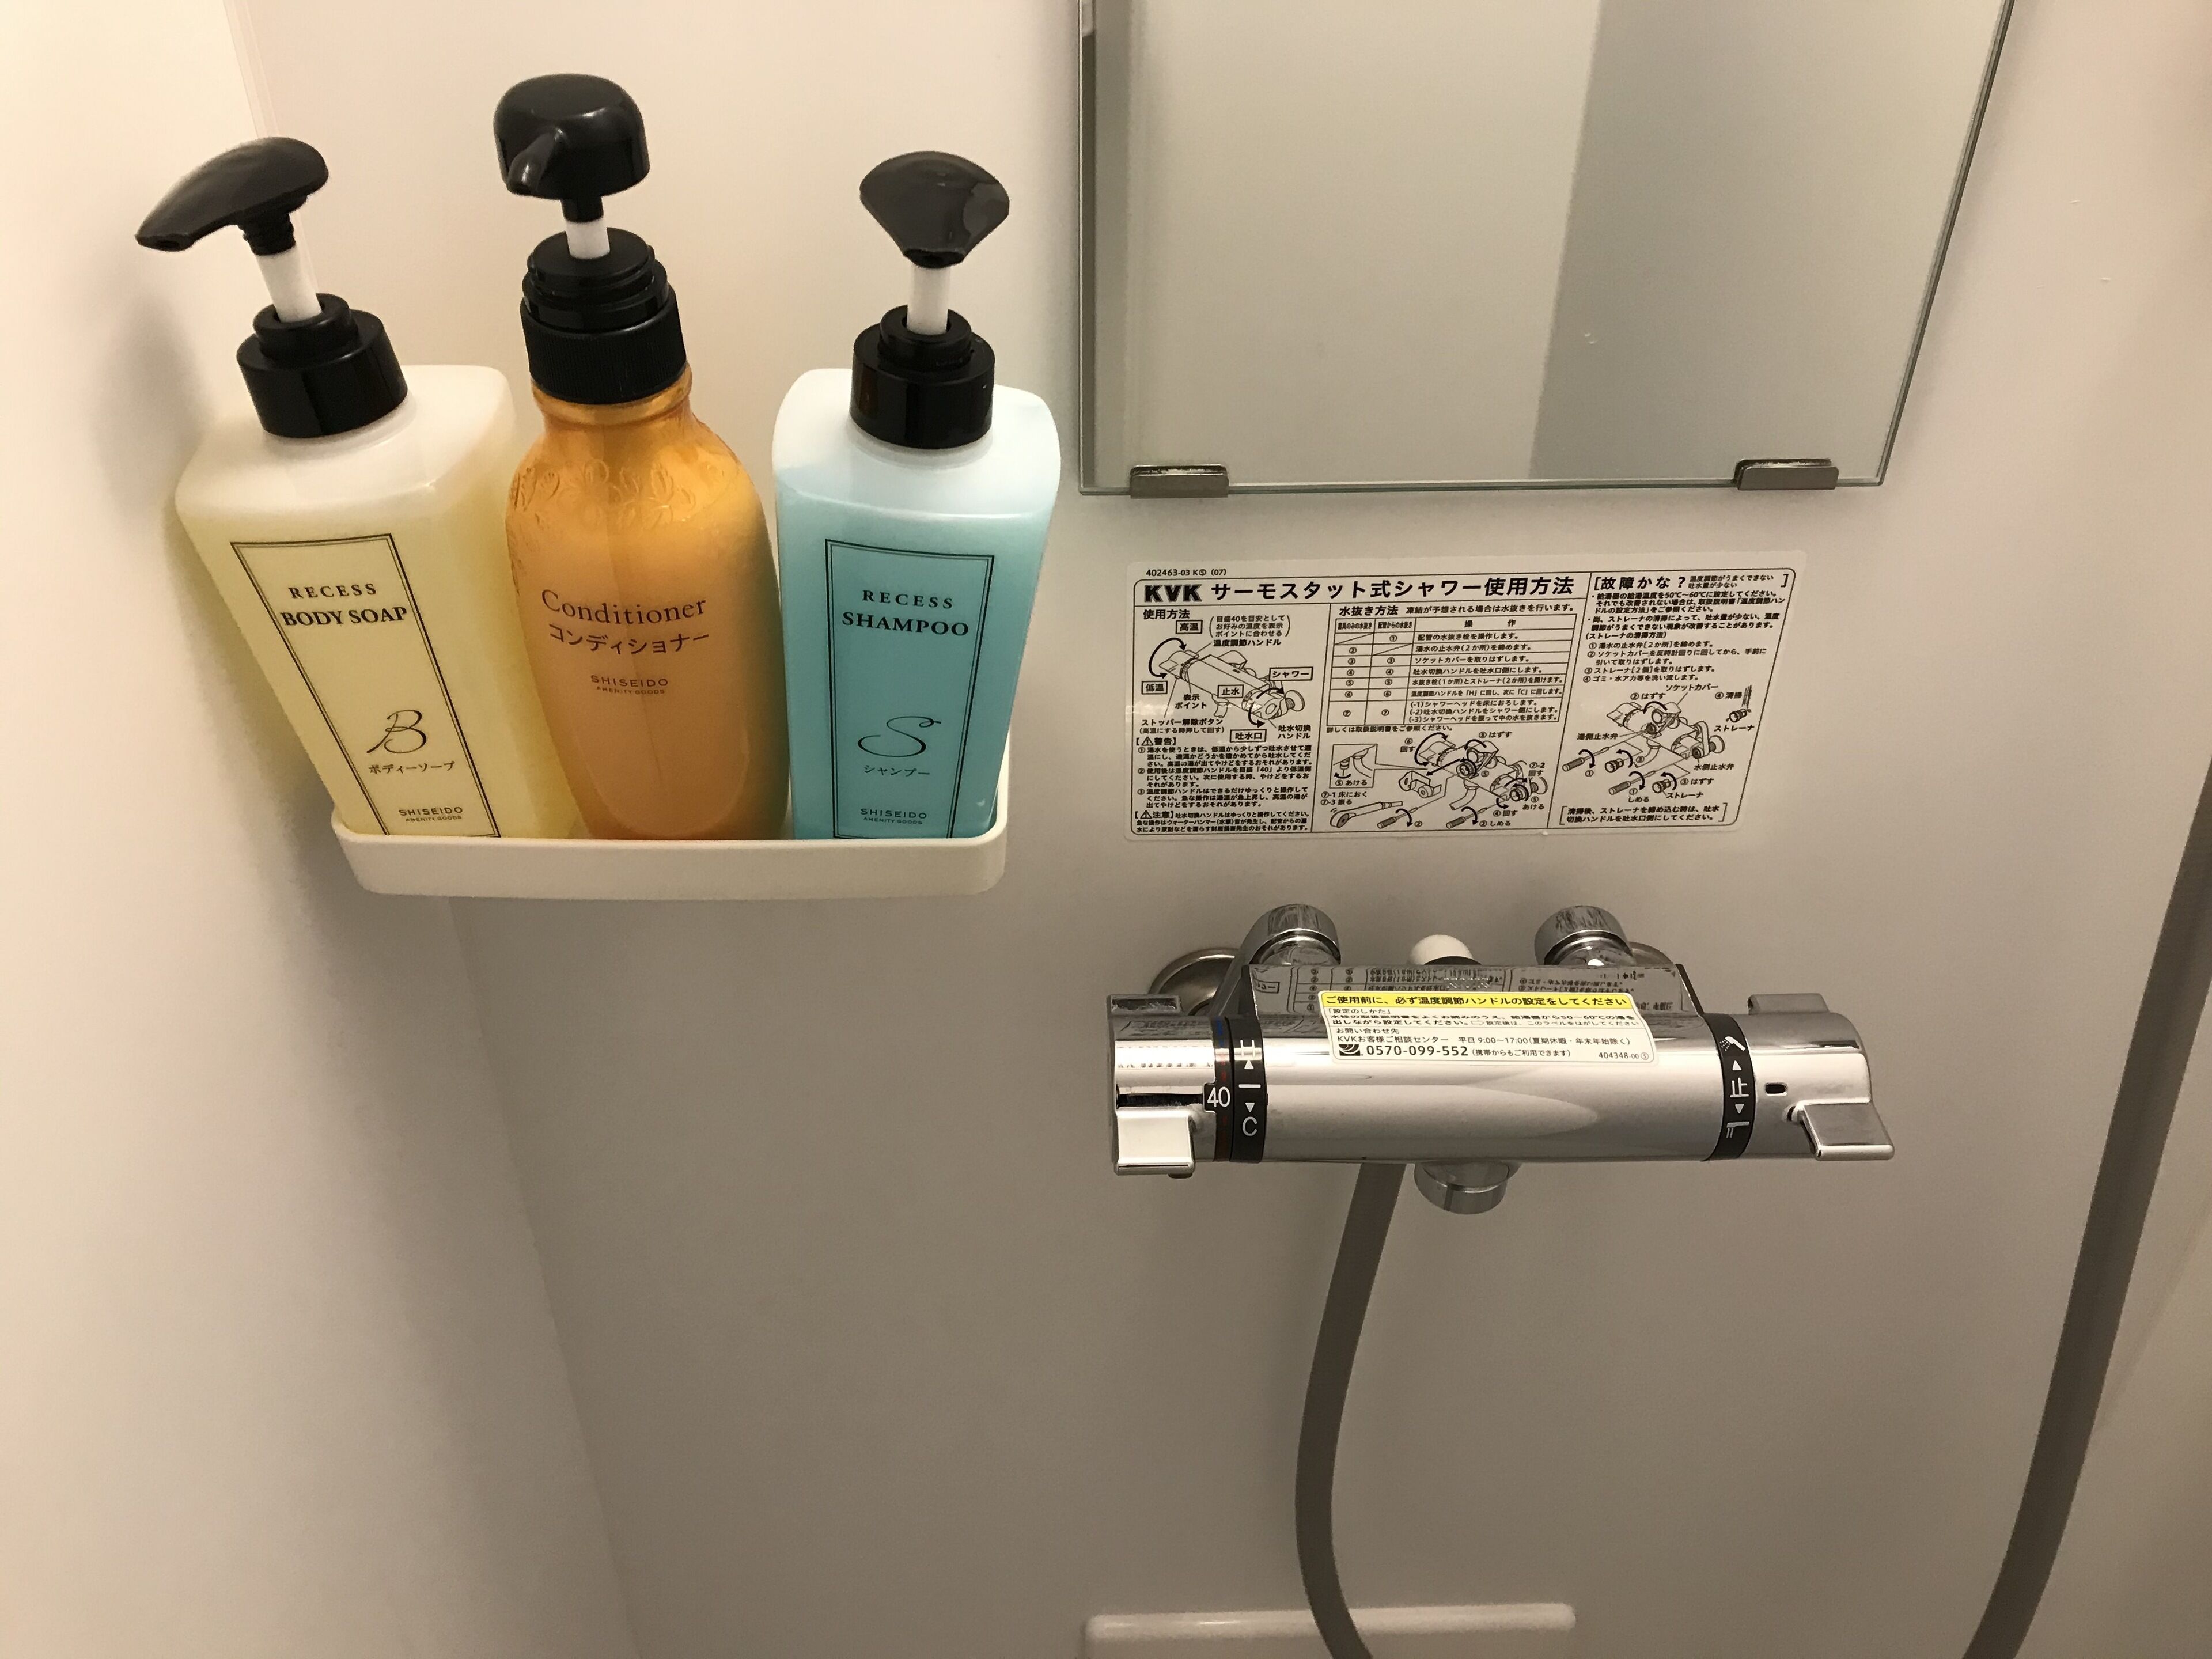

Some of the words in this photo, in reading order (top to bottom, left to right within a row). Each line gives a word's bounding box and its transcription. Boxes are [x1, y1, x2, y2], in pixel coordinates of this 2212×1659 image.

[288, 583, 377, 599] RECESS
[1144, 584, 1202, 603] KVK
[1211, 577, 1574, 600] サーモスタット式シャワー使用方法
[862, 589, 955, 610] RECESS
[541, 589, 707, 626] Conditioner
[1339, 606, 1398, 616] 水抜き方法
[281, 610, 343, 626] BODY
[348, 607, 407, 624] SOAP
[1143, 609, 1190, 620] 使用方法
[842, 611, 969, 637] SHAMPOO
[1180, 623, 1199, 631] 高温
[549, 623, 710, 656] コンディショナー
[1415, 656, 1529, 664] ソケットカバーを取りはずします。
[1272, 670, 1309, 678] シャワー
[590, 675, 668, 687] SHISEIDO
[1666, 683, 1718, 691] ソケットカバー
[597, 685, 632, 695] AMENITY
[1145, 683, 1164, 692] 低温
[1221, 688, 1240, 696] 止水
[366, 709, 427, 753] B
[857, 715, 941, 758] S
[1235, 732, 1263, 740] 吐水口
[368, 760, 455, 774] ボディーソープ
[864, 765, 930, 777] シャンプー
[399, 806, 463, 816] SHISEIDO
[860, 808, 927, 819] SHISEIDO
[1326, 996, 1627, 1006] ご使用前に、必ず温度調節ハンドルの設定をしてください
[1366, 1045, 1468, 1056] 0570-099-552
[1730, 1077, 1749, 1098] 止
[1207, 1086, 1230, 1107] 40
[1242, 1116, 1257, 1137] C
